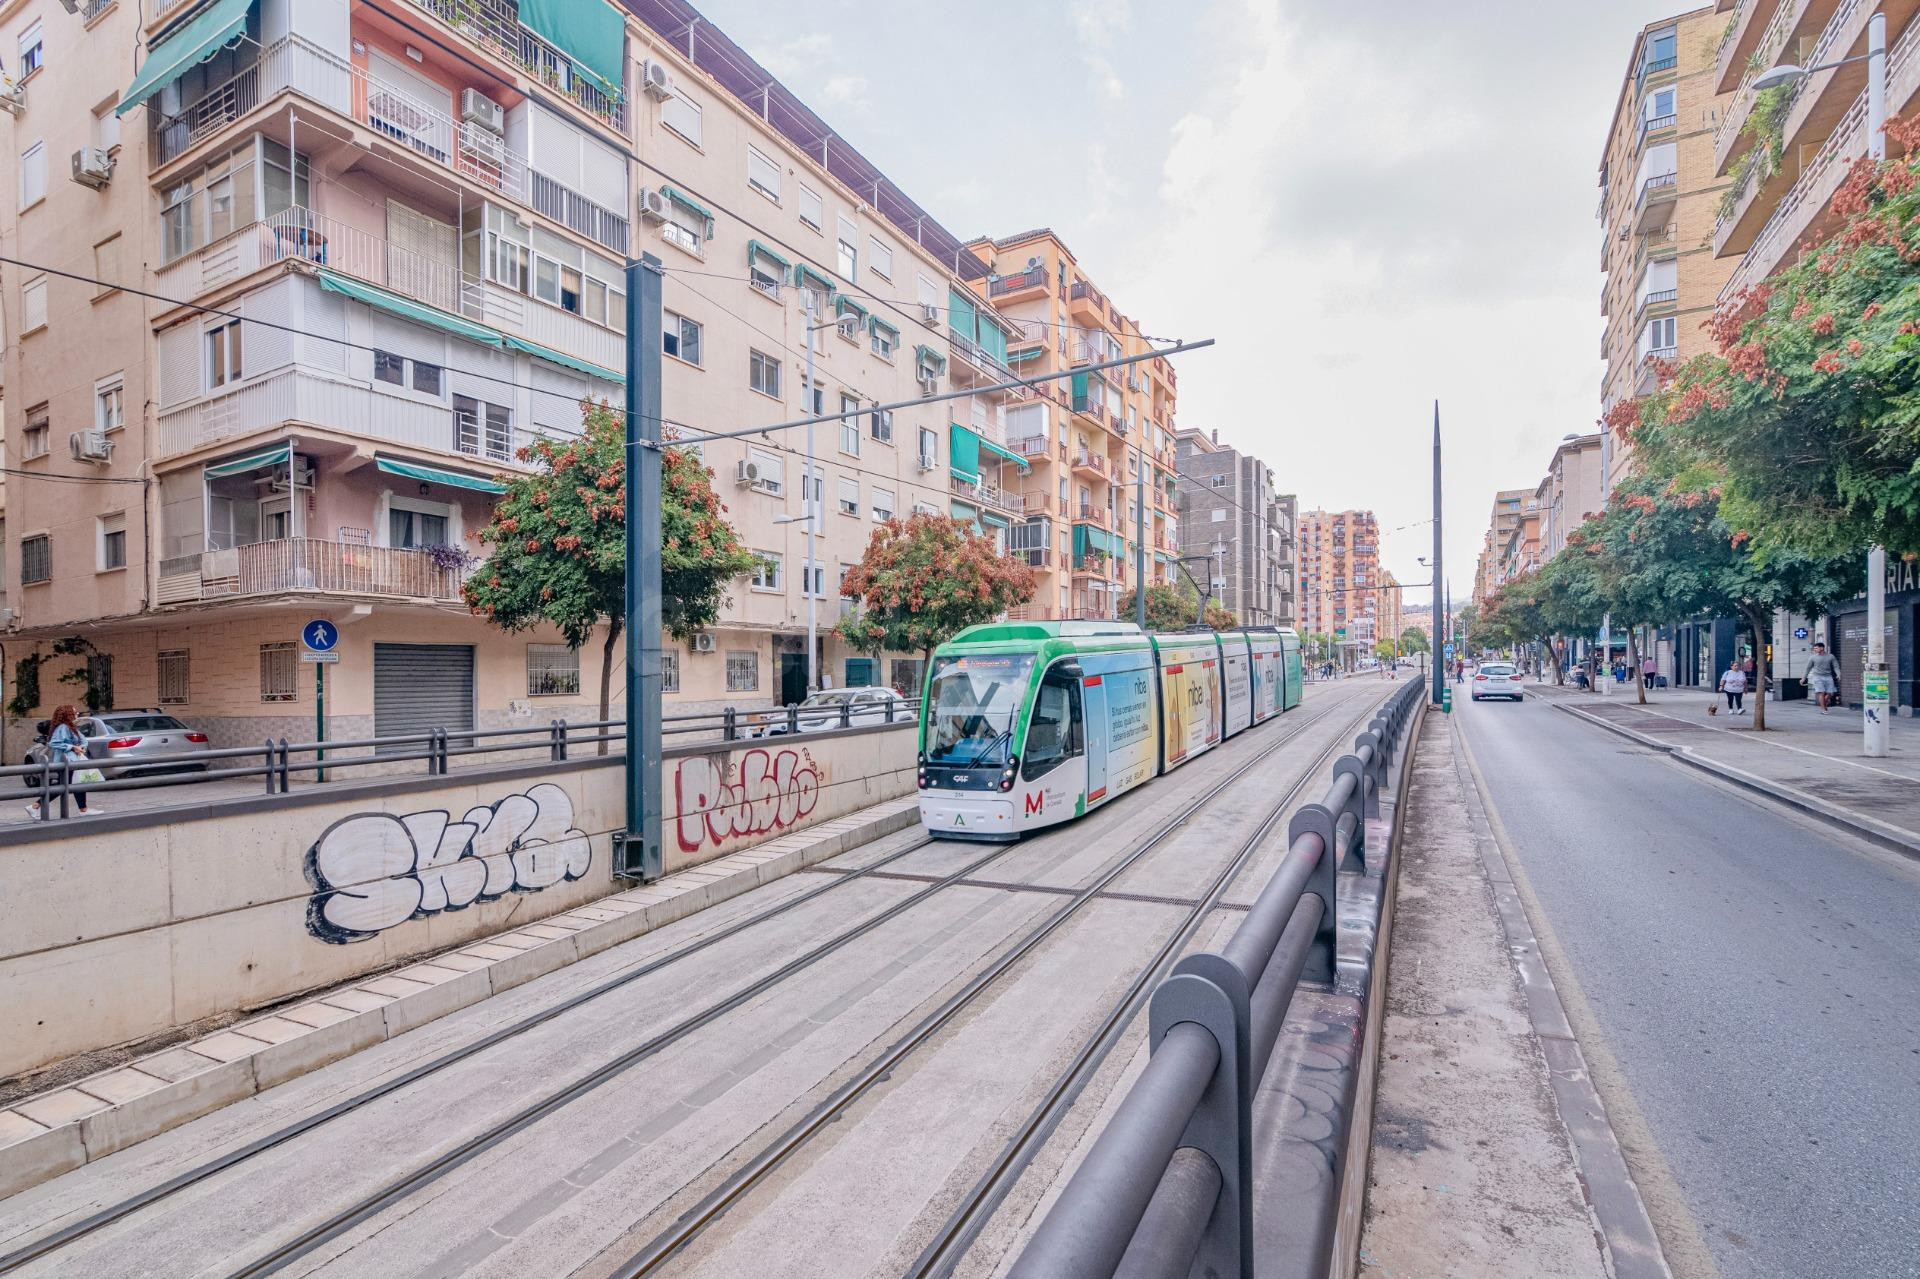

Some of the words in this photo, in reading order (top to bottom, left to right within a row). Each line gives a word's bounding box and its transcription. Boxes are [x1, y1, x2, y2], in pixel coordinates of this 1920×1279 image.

[1134, 678, 1147, 696] niba
[1188, 680, 1203, 708] niba
[1025, 790, 1043, 818] M
